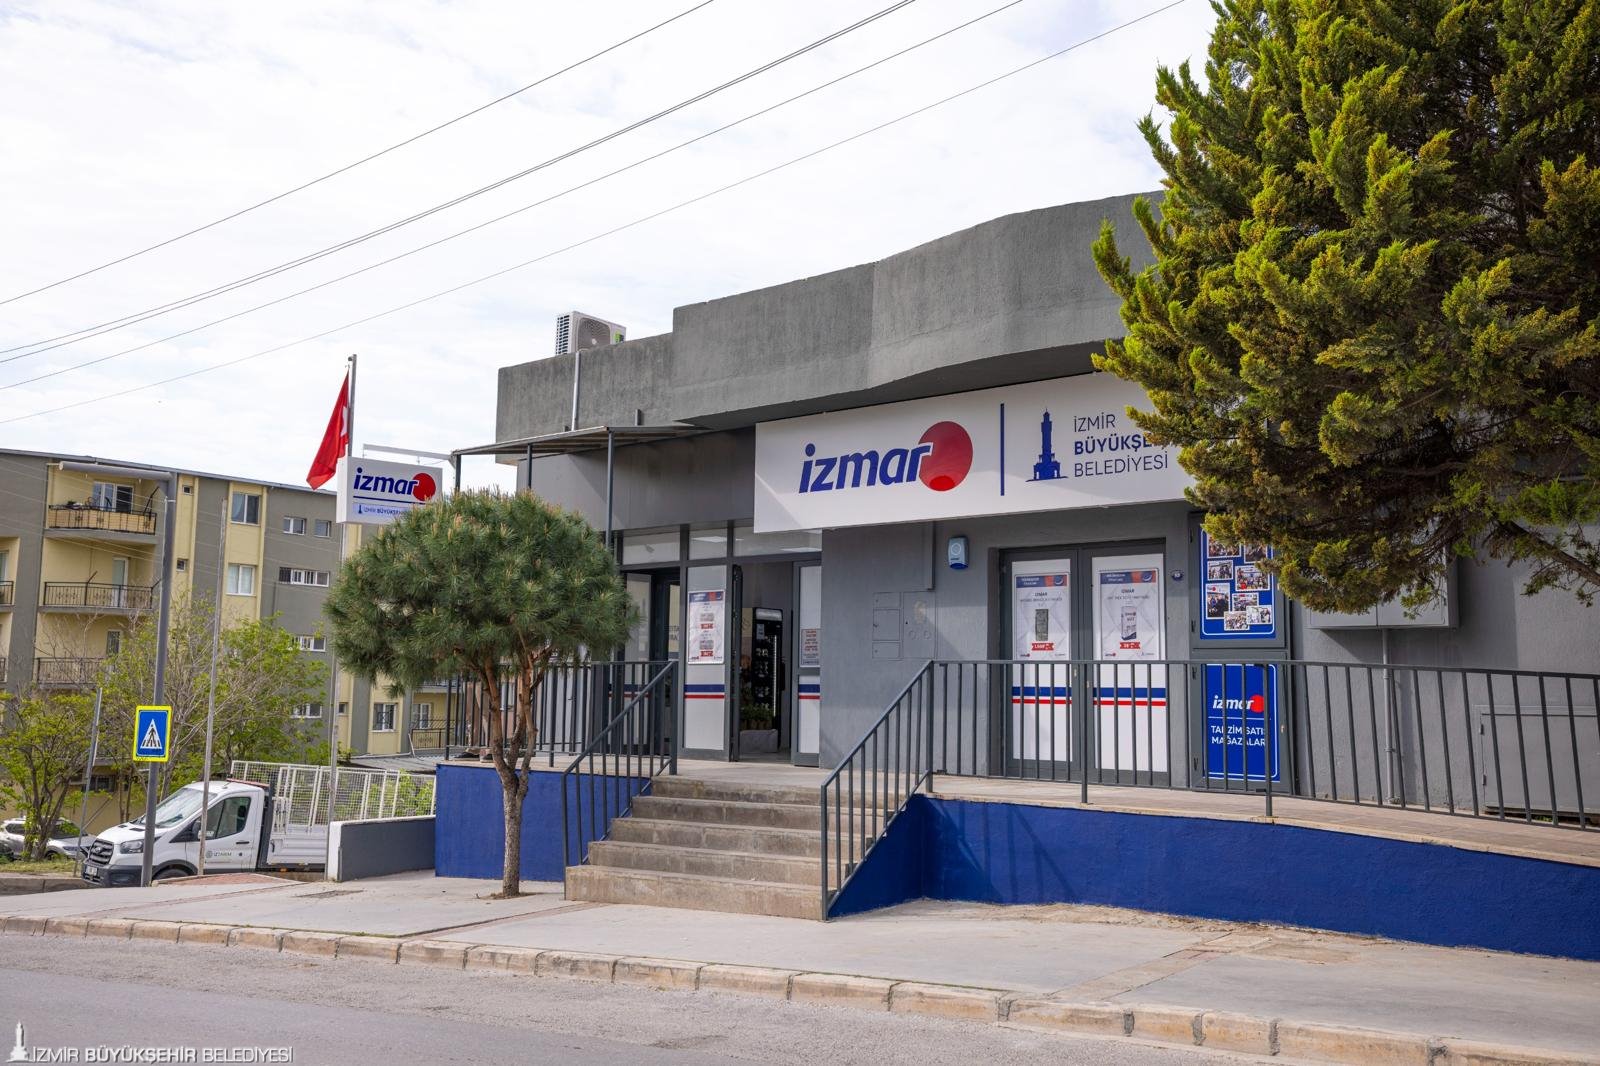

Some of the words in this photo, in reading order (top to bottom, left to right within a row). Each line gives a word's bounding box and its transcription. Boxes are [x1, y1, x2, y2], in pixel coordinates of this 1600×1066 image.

[1073, 412, 1116, 432] İZMİR
[799, 443, 932, 494] izmar
[1074, 451, 1168, 477] BELEDİYESİ
[353, 467, 419, 495] izmar
[1211, 725, 1243, 734] TAZİM
